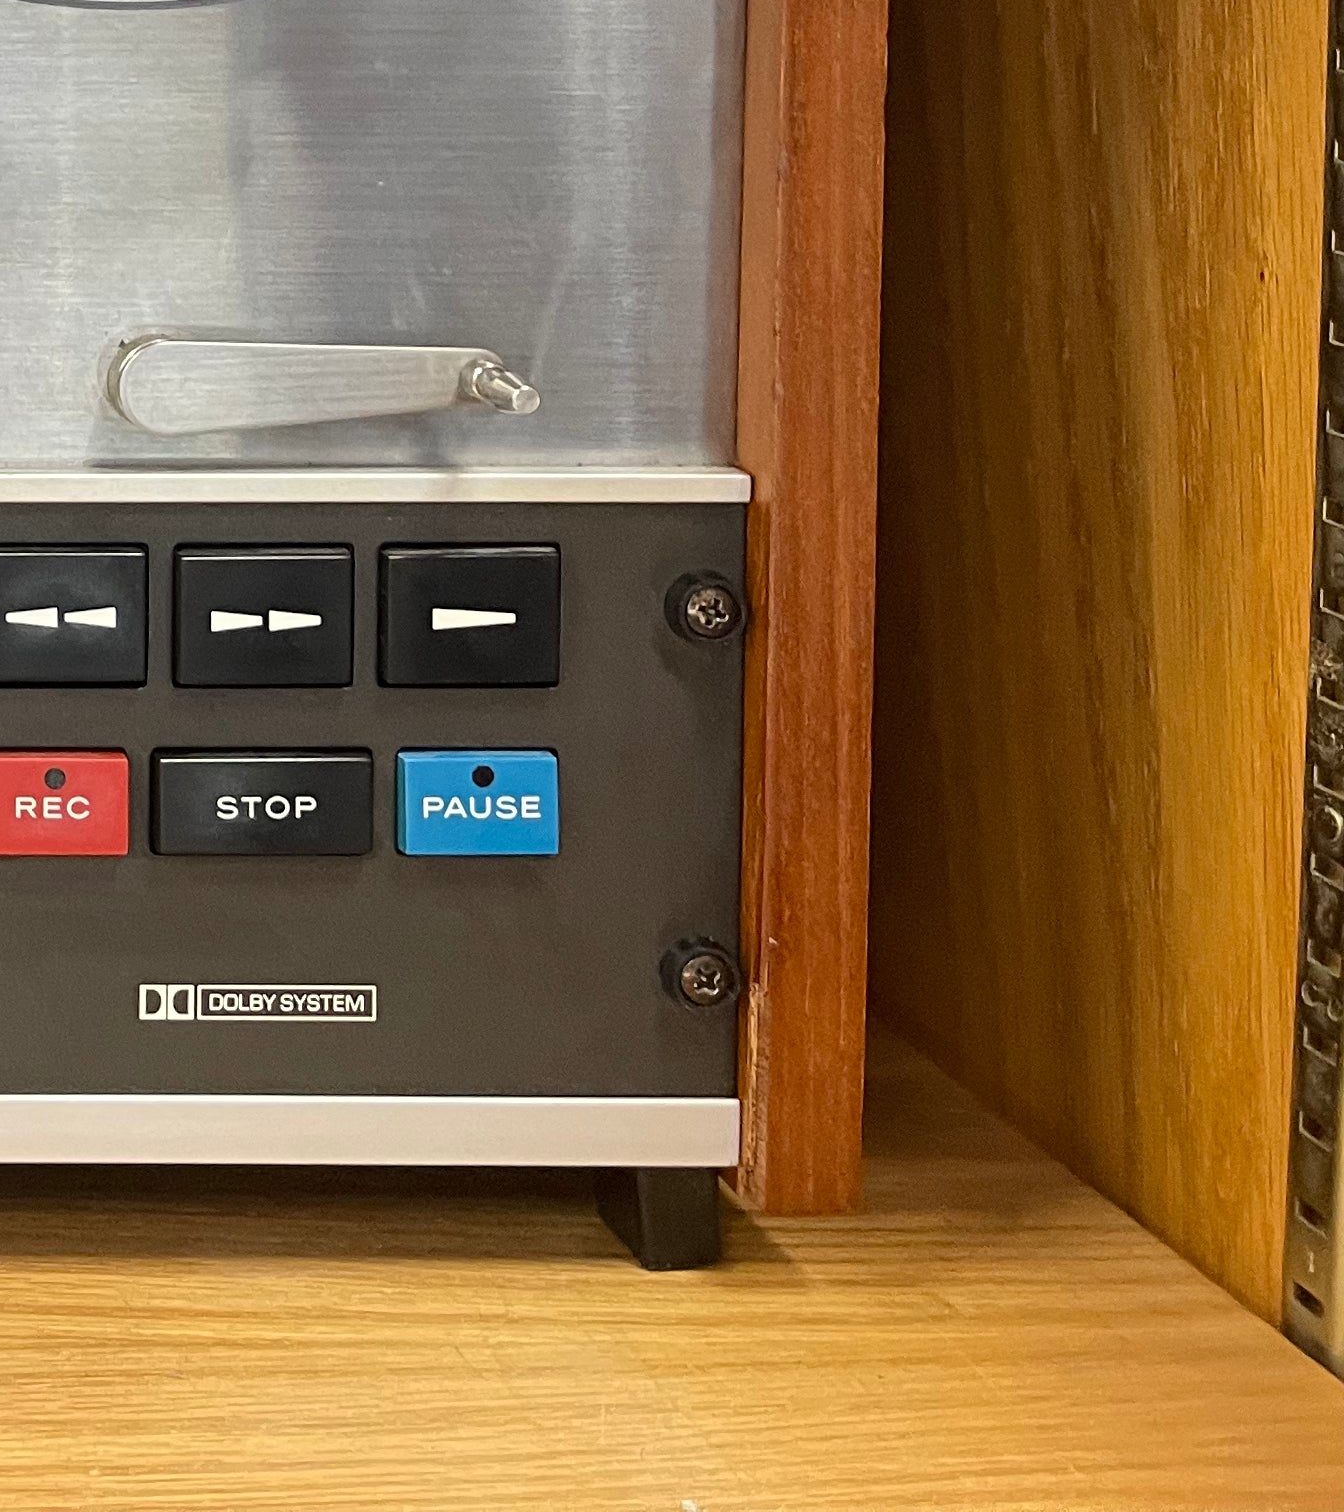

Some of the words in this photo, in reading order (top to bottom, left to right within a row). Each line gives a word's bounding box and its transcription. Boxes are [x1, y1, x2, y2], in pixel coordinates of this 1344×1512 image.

[15, 796, 90, 820] REC
[216, 795, 317, 821] STOP
[422, 795, 542, 820] PAUSE
[208, 993, 277, 1012] DOLBY
[279, 993, 365, 1013] SYSTEM
